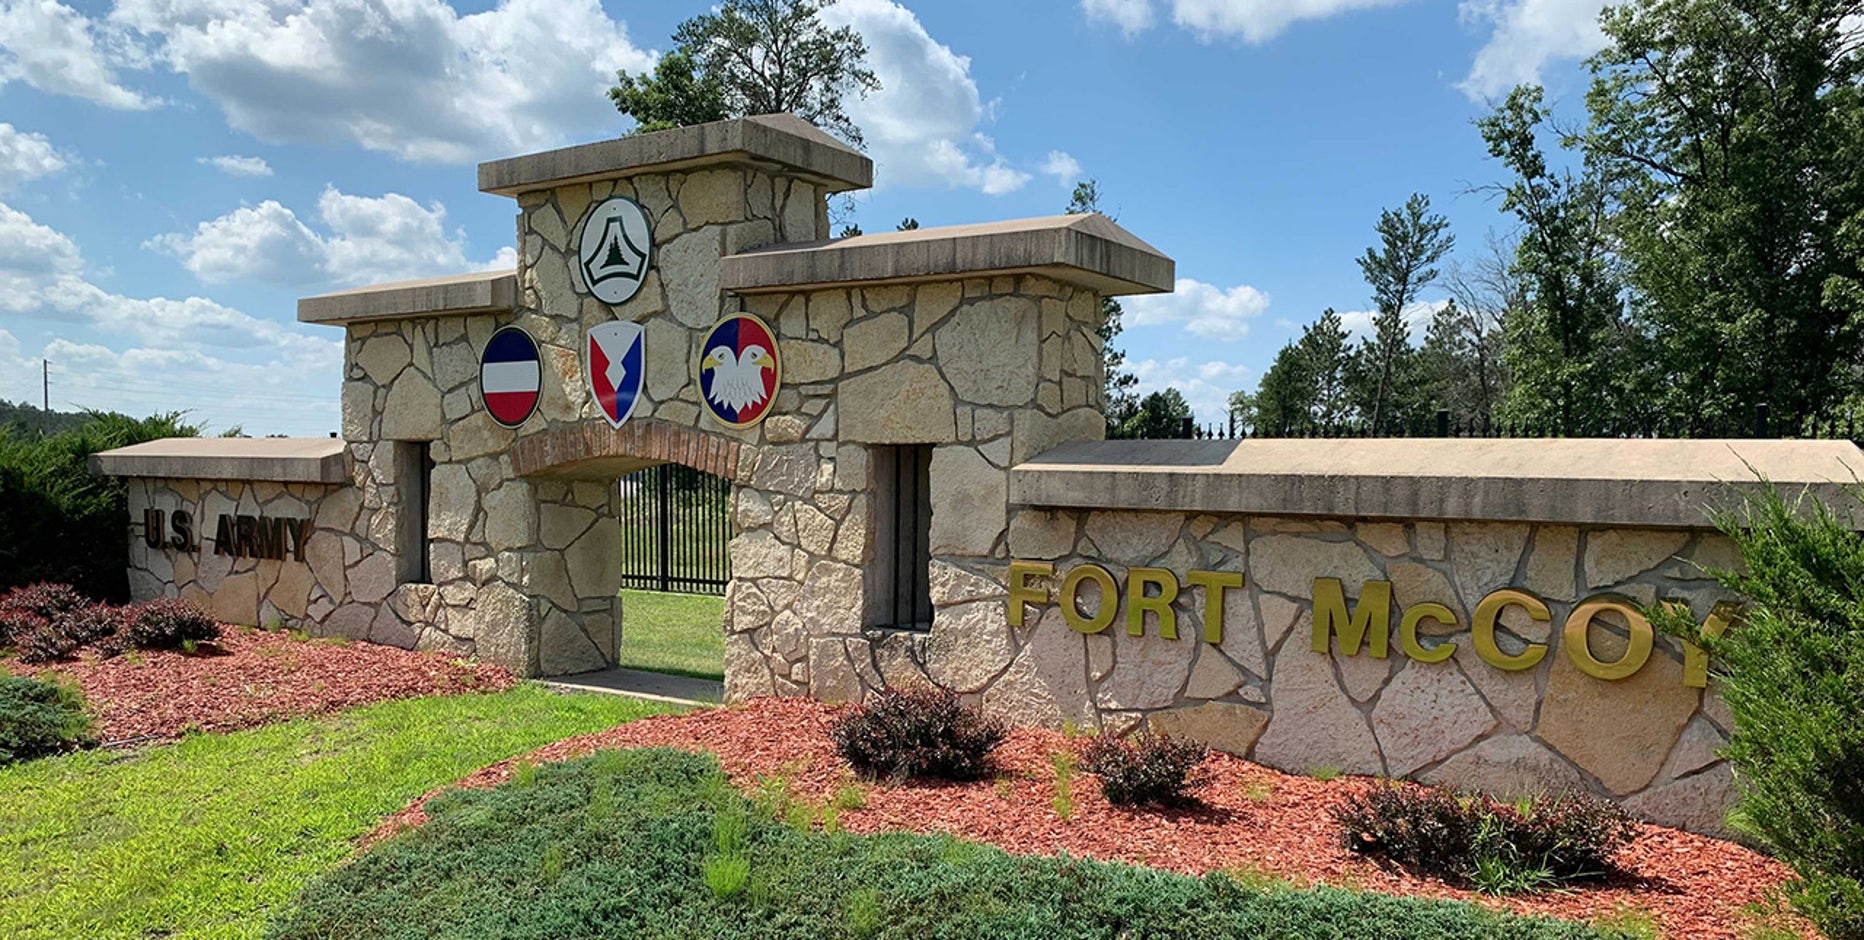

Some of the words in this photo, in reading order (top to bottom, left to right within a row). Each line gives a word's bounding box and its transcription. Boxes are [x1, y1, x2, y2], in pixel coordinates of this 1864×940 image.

[144, 509, 201, 552] U.S.
[214, 514, 312, 563] ARMY
[1008, 560, 1244, 643] FORT
[1311, 577, 1743, 688] McCOY
